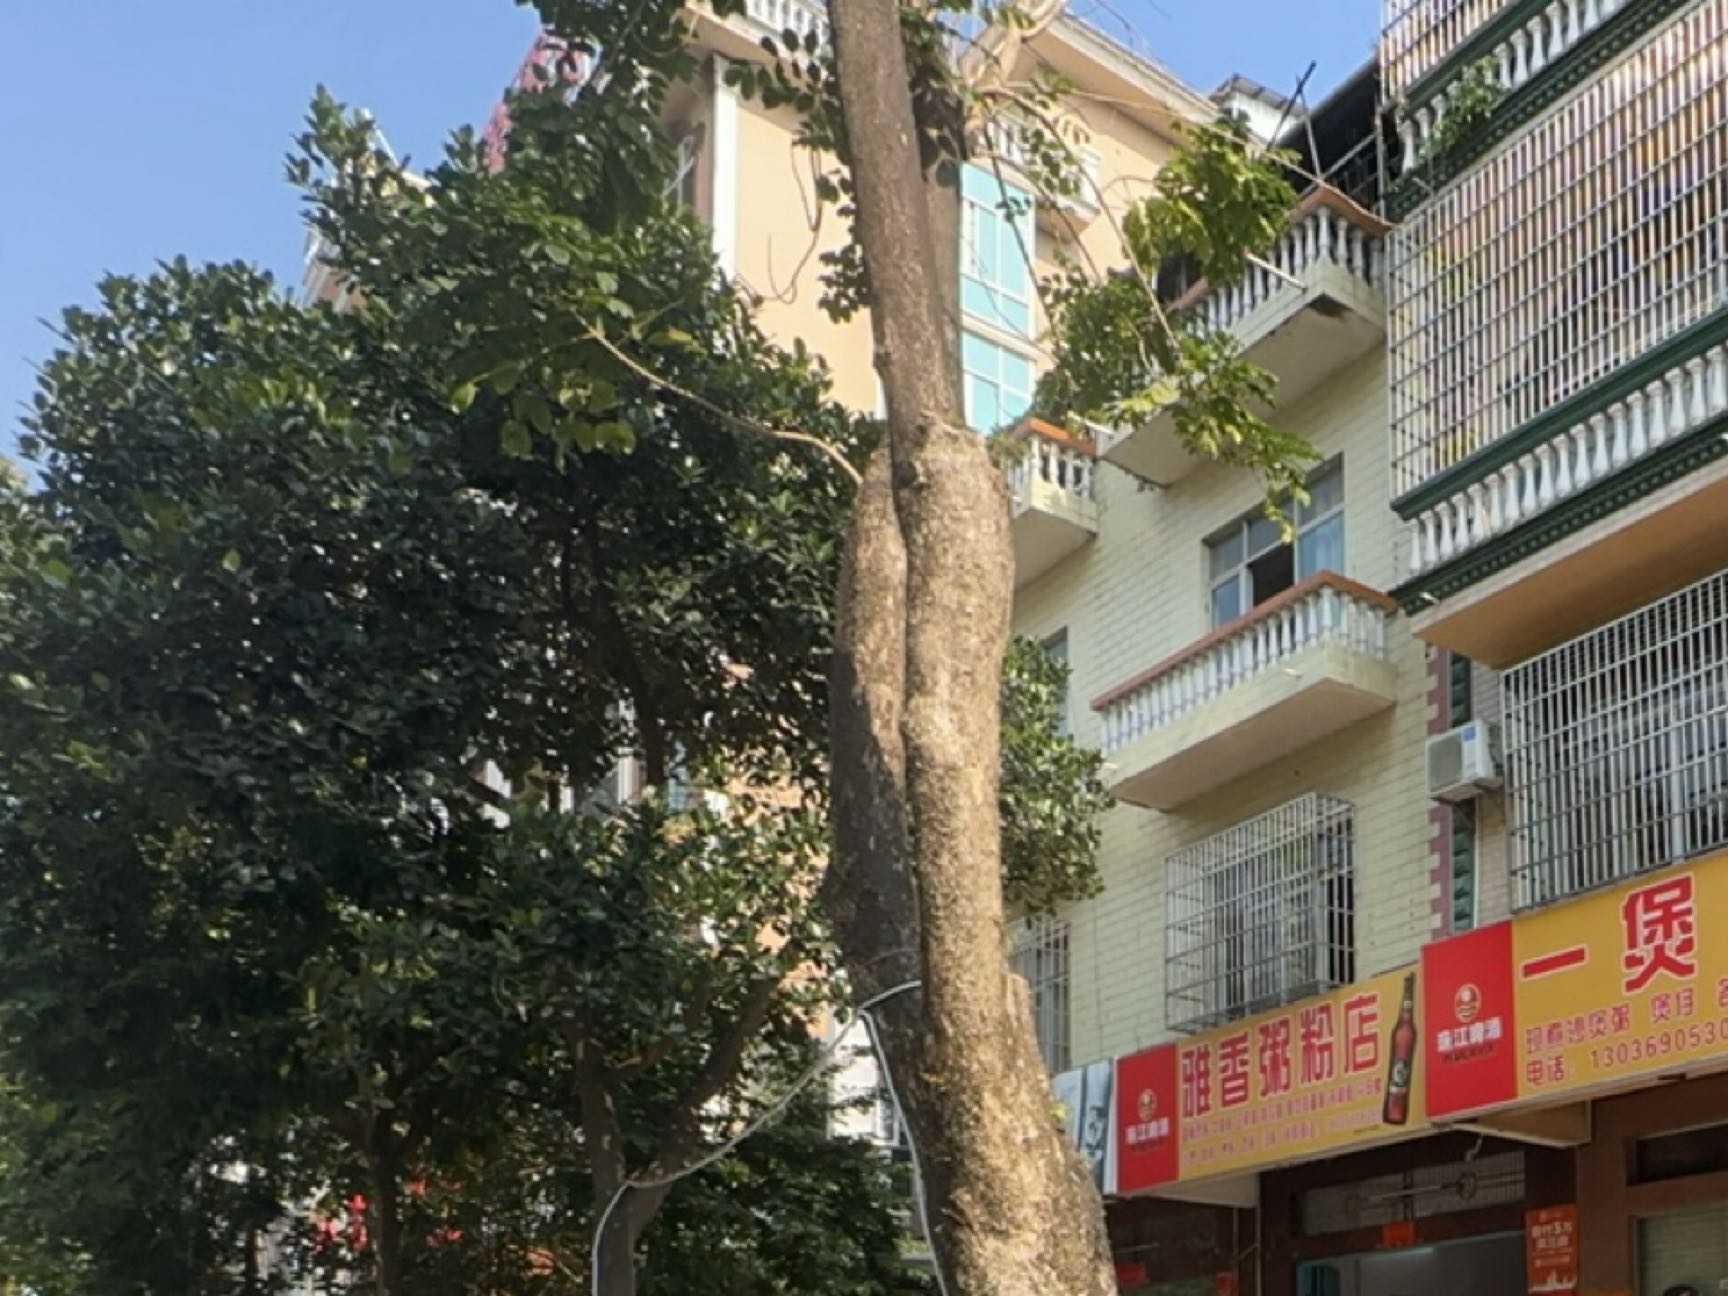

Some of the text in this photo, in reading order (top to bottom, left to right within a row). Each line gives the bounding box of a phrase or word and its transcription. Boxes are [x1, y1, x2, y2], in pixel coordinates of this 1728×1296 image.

[1180, 992, 1380, 1119] 雅香粥粉店
